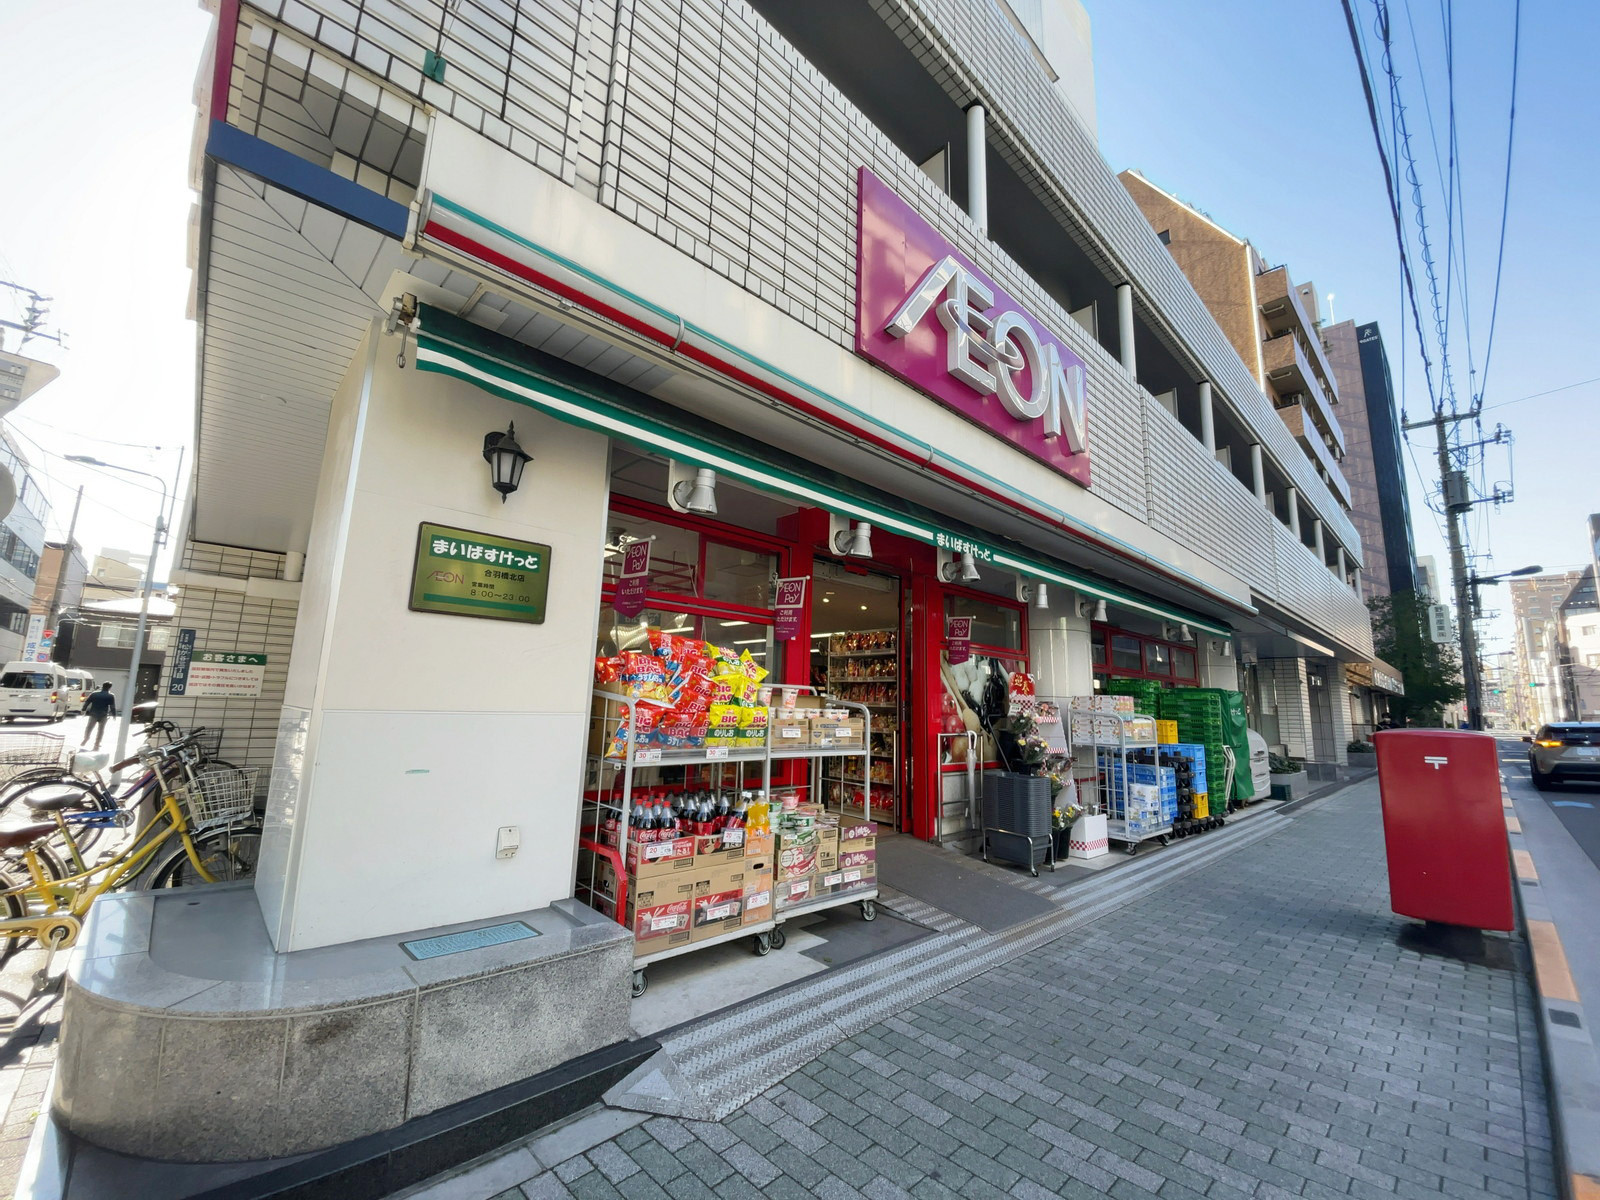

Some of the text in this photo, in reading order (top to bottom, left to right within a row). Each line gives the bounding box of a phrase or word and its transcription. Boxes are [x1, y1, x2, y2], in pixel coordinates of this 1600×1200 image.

[936, 532, 991, 562] まいばすけっと
[432, 539, 538, 569] まいばすけっと
[484, 569, 525, 583] 合羽橋北店
[202, 653, 258, 663] お客さまへ
[638, 656, 658, 667] BIG
[636, 665, 661, 674] BAG
[690, 664, 708, 676] BIG
[171, 683, 184, 692] 20
[694, 685, 711, 696] BIG
[721, 715, 738, 723] BIG
[635, 725, 651, 733] AG
[713, 729, 734, 738] のりしお
[745, 729, 765, 738] のりしお
